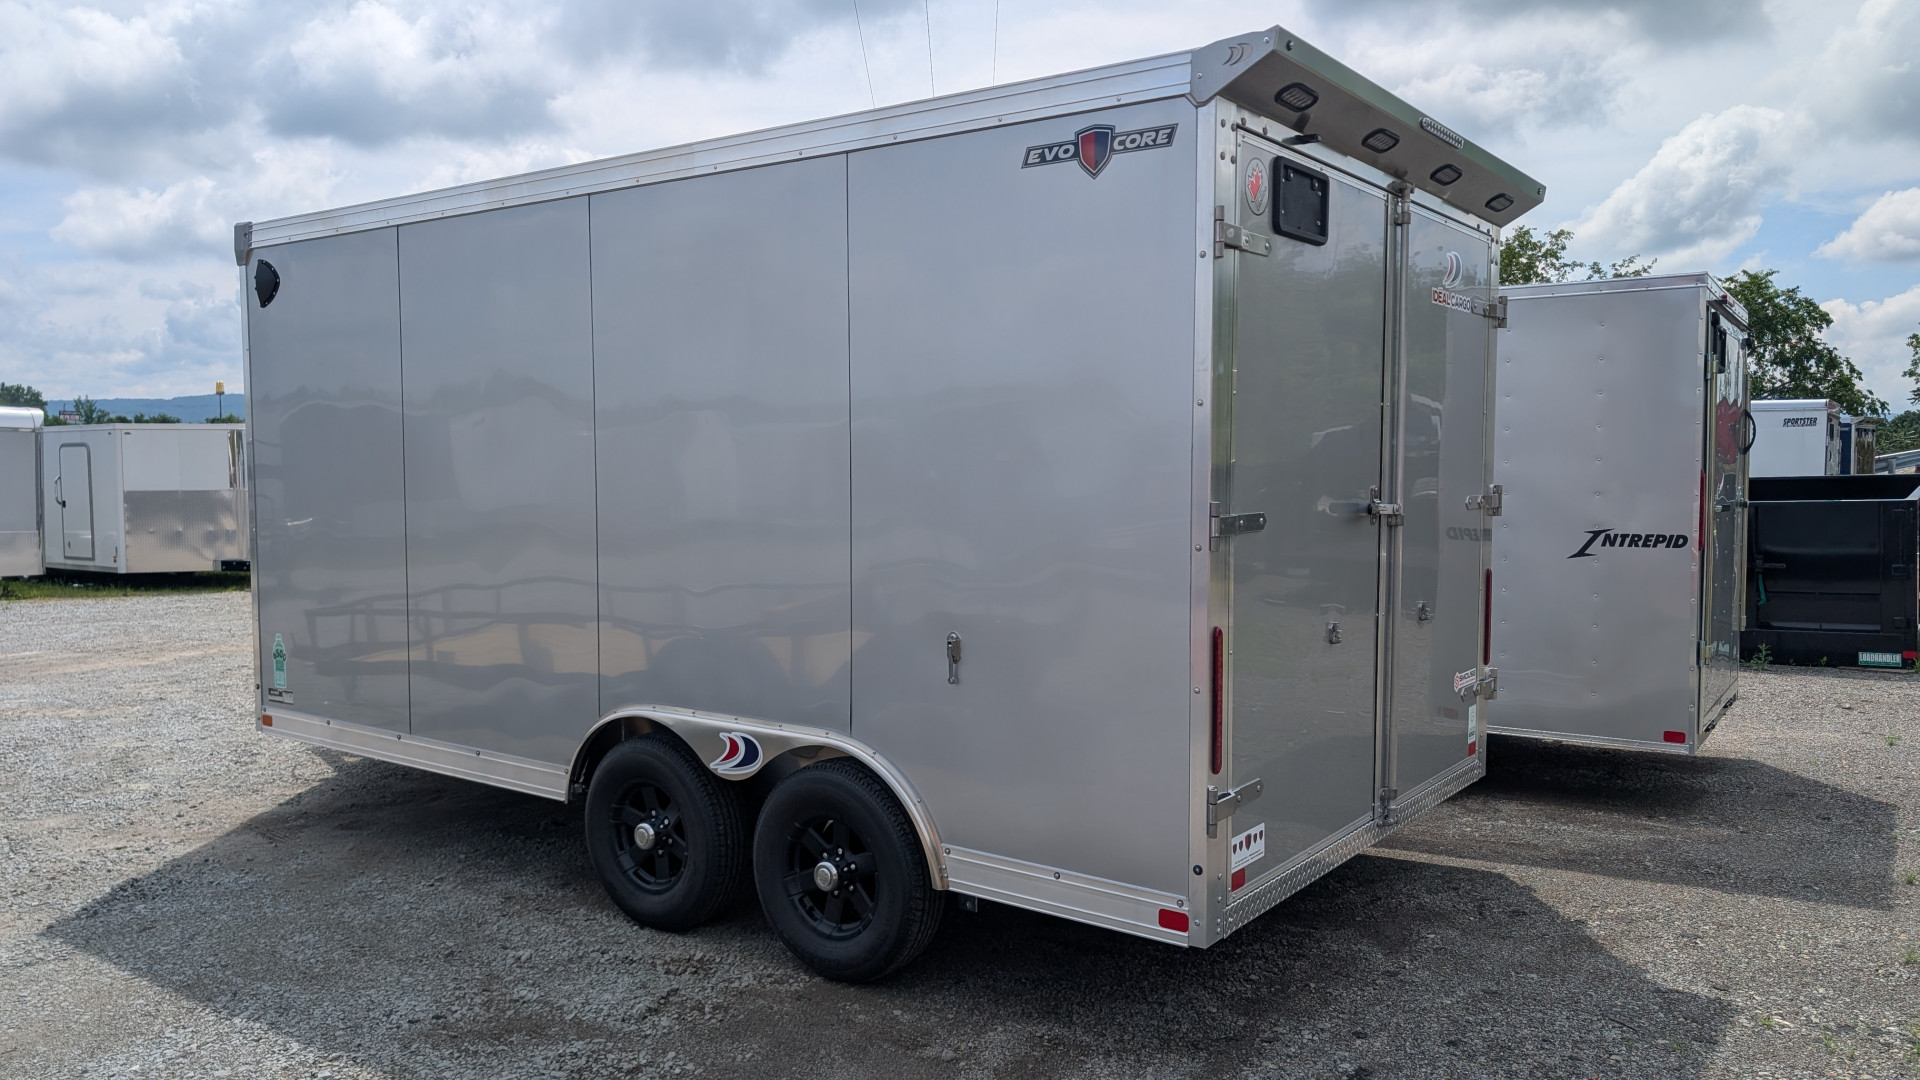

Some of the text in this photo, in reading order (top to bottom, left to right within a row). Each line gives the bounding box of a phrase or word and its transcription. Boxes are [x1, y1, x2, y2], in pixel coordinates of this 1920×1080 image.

[1027, 128, 1172, 164] EVO CORE
[1451, 293, 1470, 312] CARGO
[1783, 417, 1818, 425] SPORTSTER
[1566, 528, 1688, 559] INTREPID
[1859, 653, 1900, 663] LOADHANDLER
